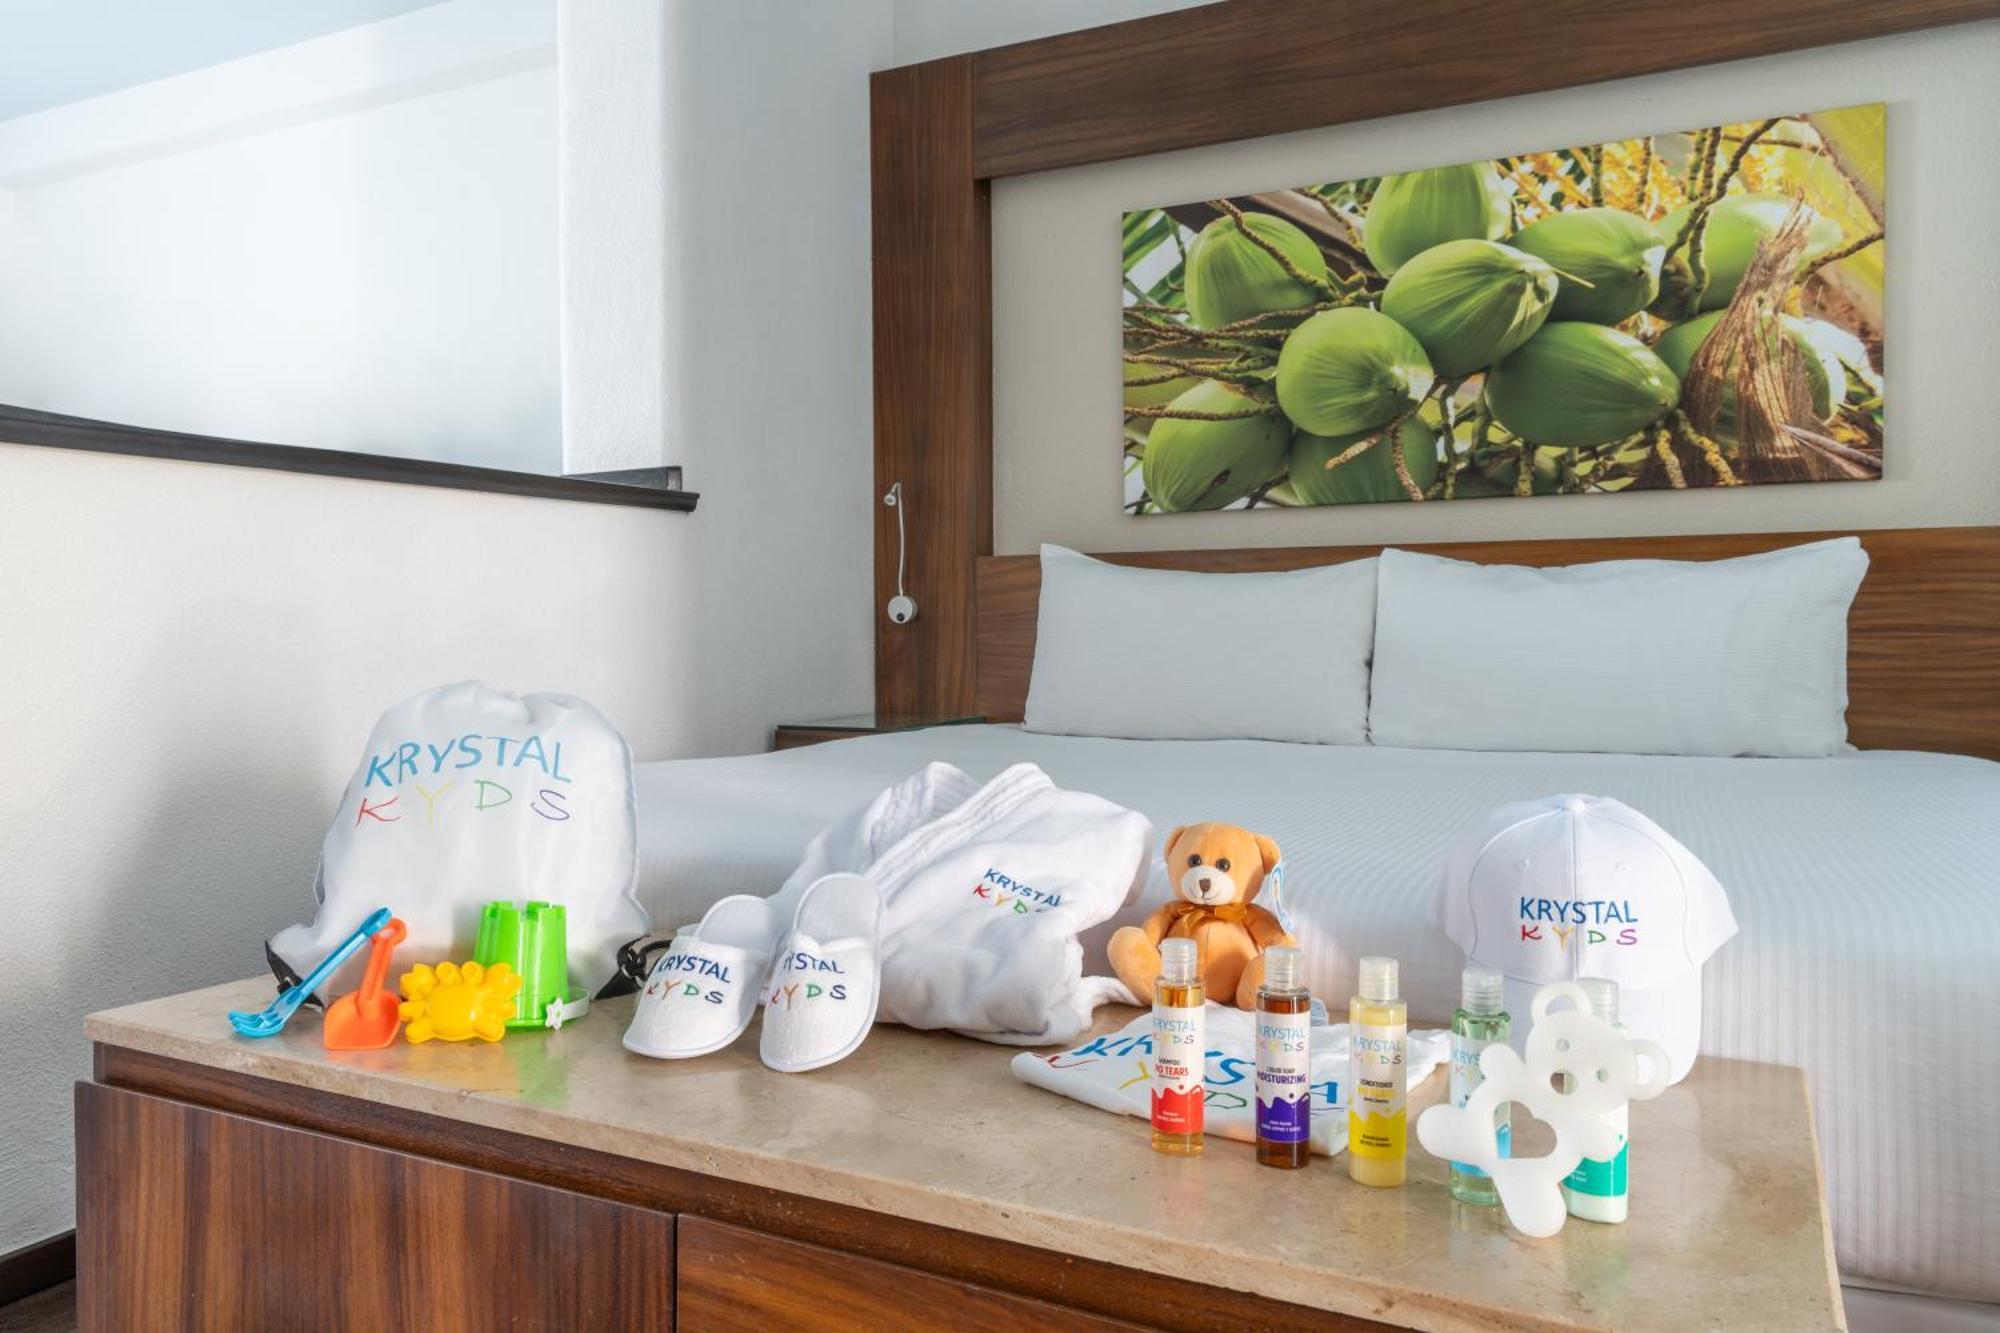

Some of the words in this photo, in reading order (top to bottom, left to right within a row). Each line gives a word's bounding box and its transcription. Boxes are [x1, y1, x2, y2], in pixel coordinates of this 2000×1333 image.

[364, 734, 573, 788] KRYSTAL
[354, 779, 572, 832] KYDS
[983, 868, 1061, 907] KRYSTAL
[1520, 896, 1638, 924] KRYSTAL
[1521, 924, 1638, 951] KYDS
[1165, 1065, 1189, 1077] TEARS
[1257, 1070, 1306, 1084] MOISTURIZING
